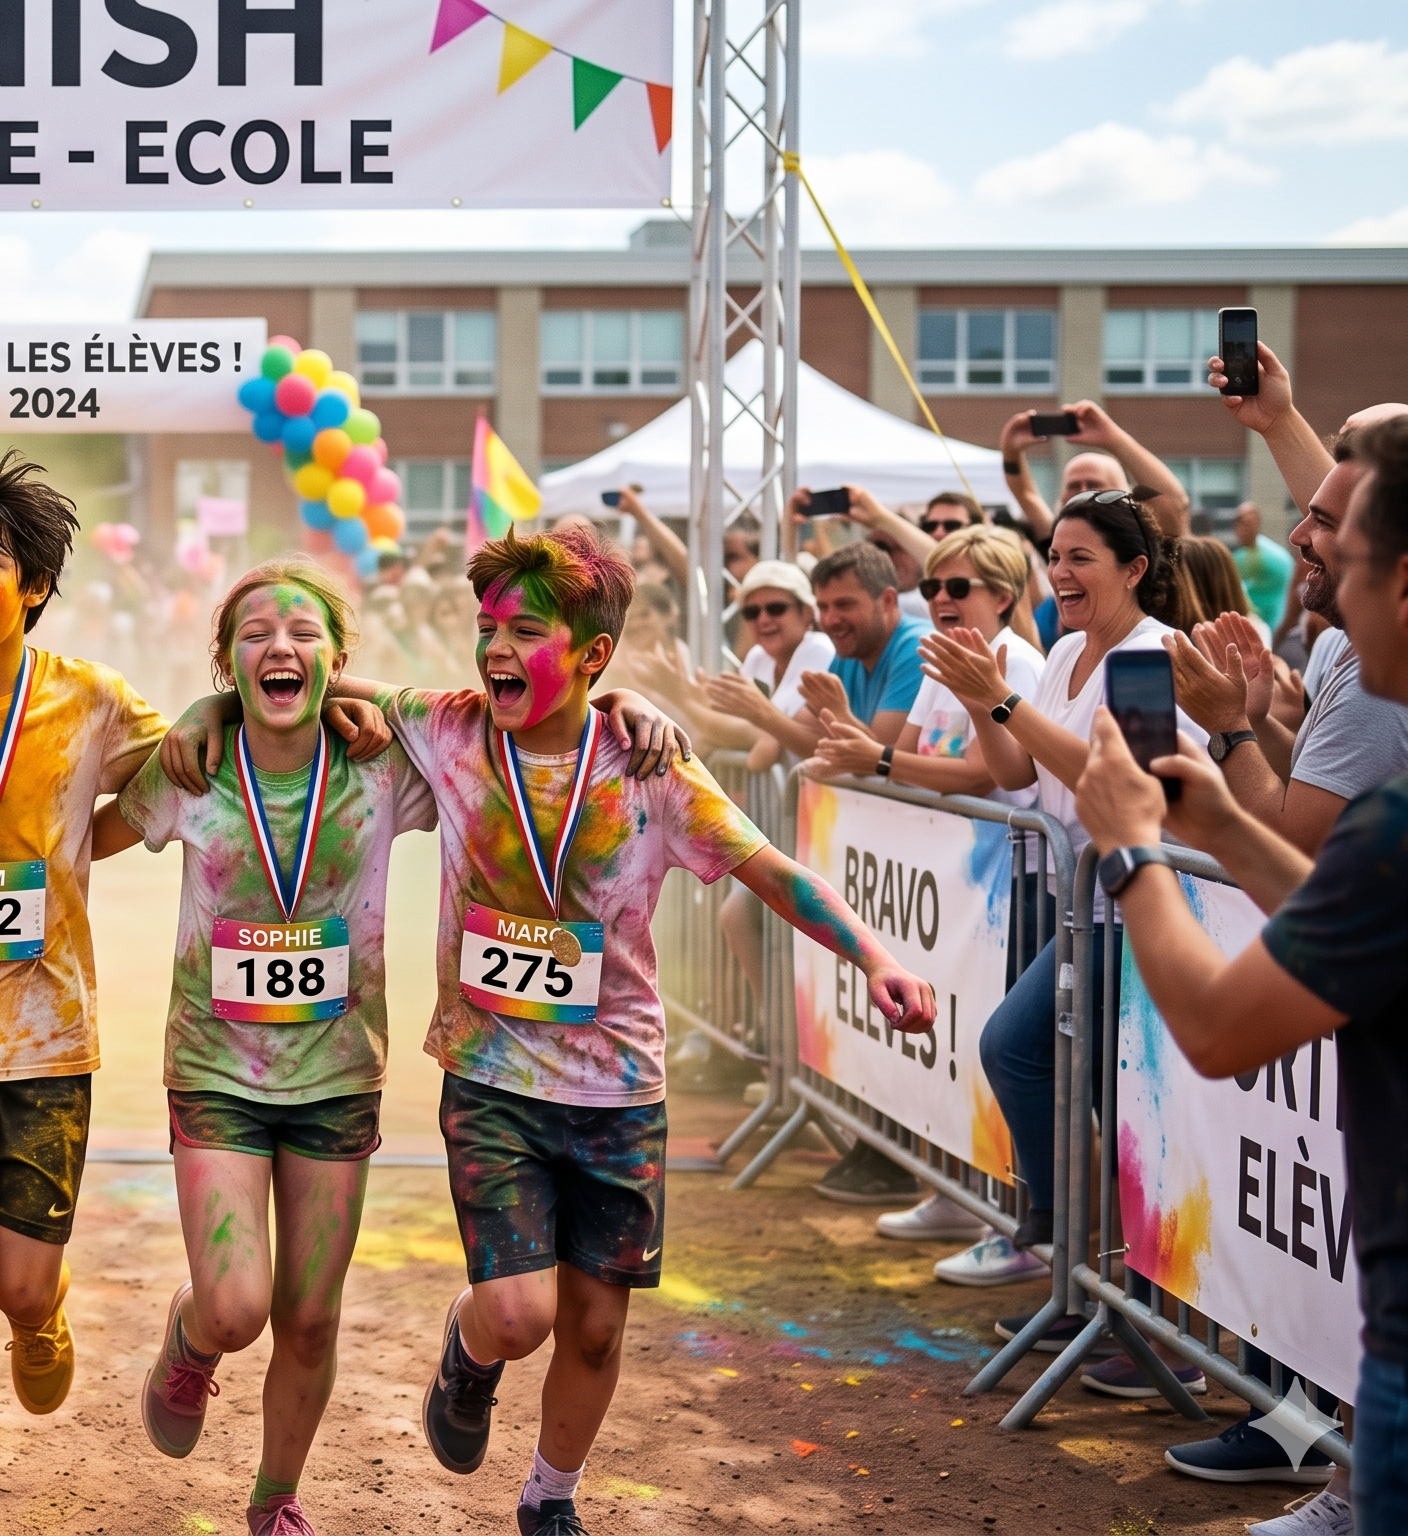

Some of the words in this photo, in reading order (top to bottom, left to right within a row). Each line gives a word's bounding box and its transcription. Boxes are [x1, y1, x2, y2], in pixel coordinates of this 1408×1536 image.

[125, 119, 394, 186] ECOLE
[7, 342, 72, 374] LES
[84, 333, 222, 374] ÉLÈVES
[9, 387, 101, 419] 2024
[845, 845, 939, 952] BRAVO
[238, 928, 323, 947] SOPHIE
[237, 957, 326, 998] 188
[481, 947, 574, 998] 275
